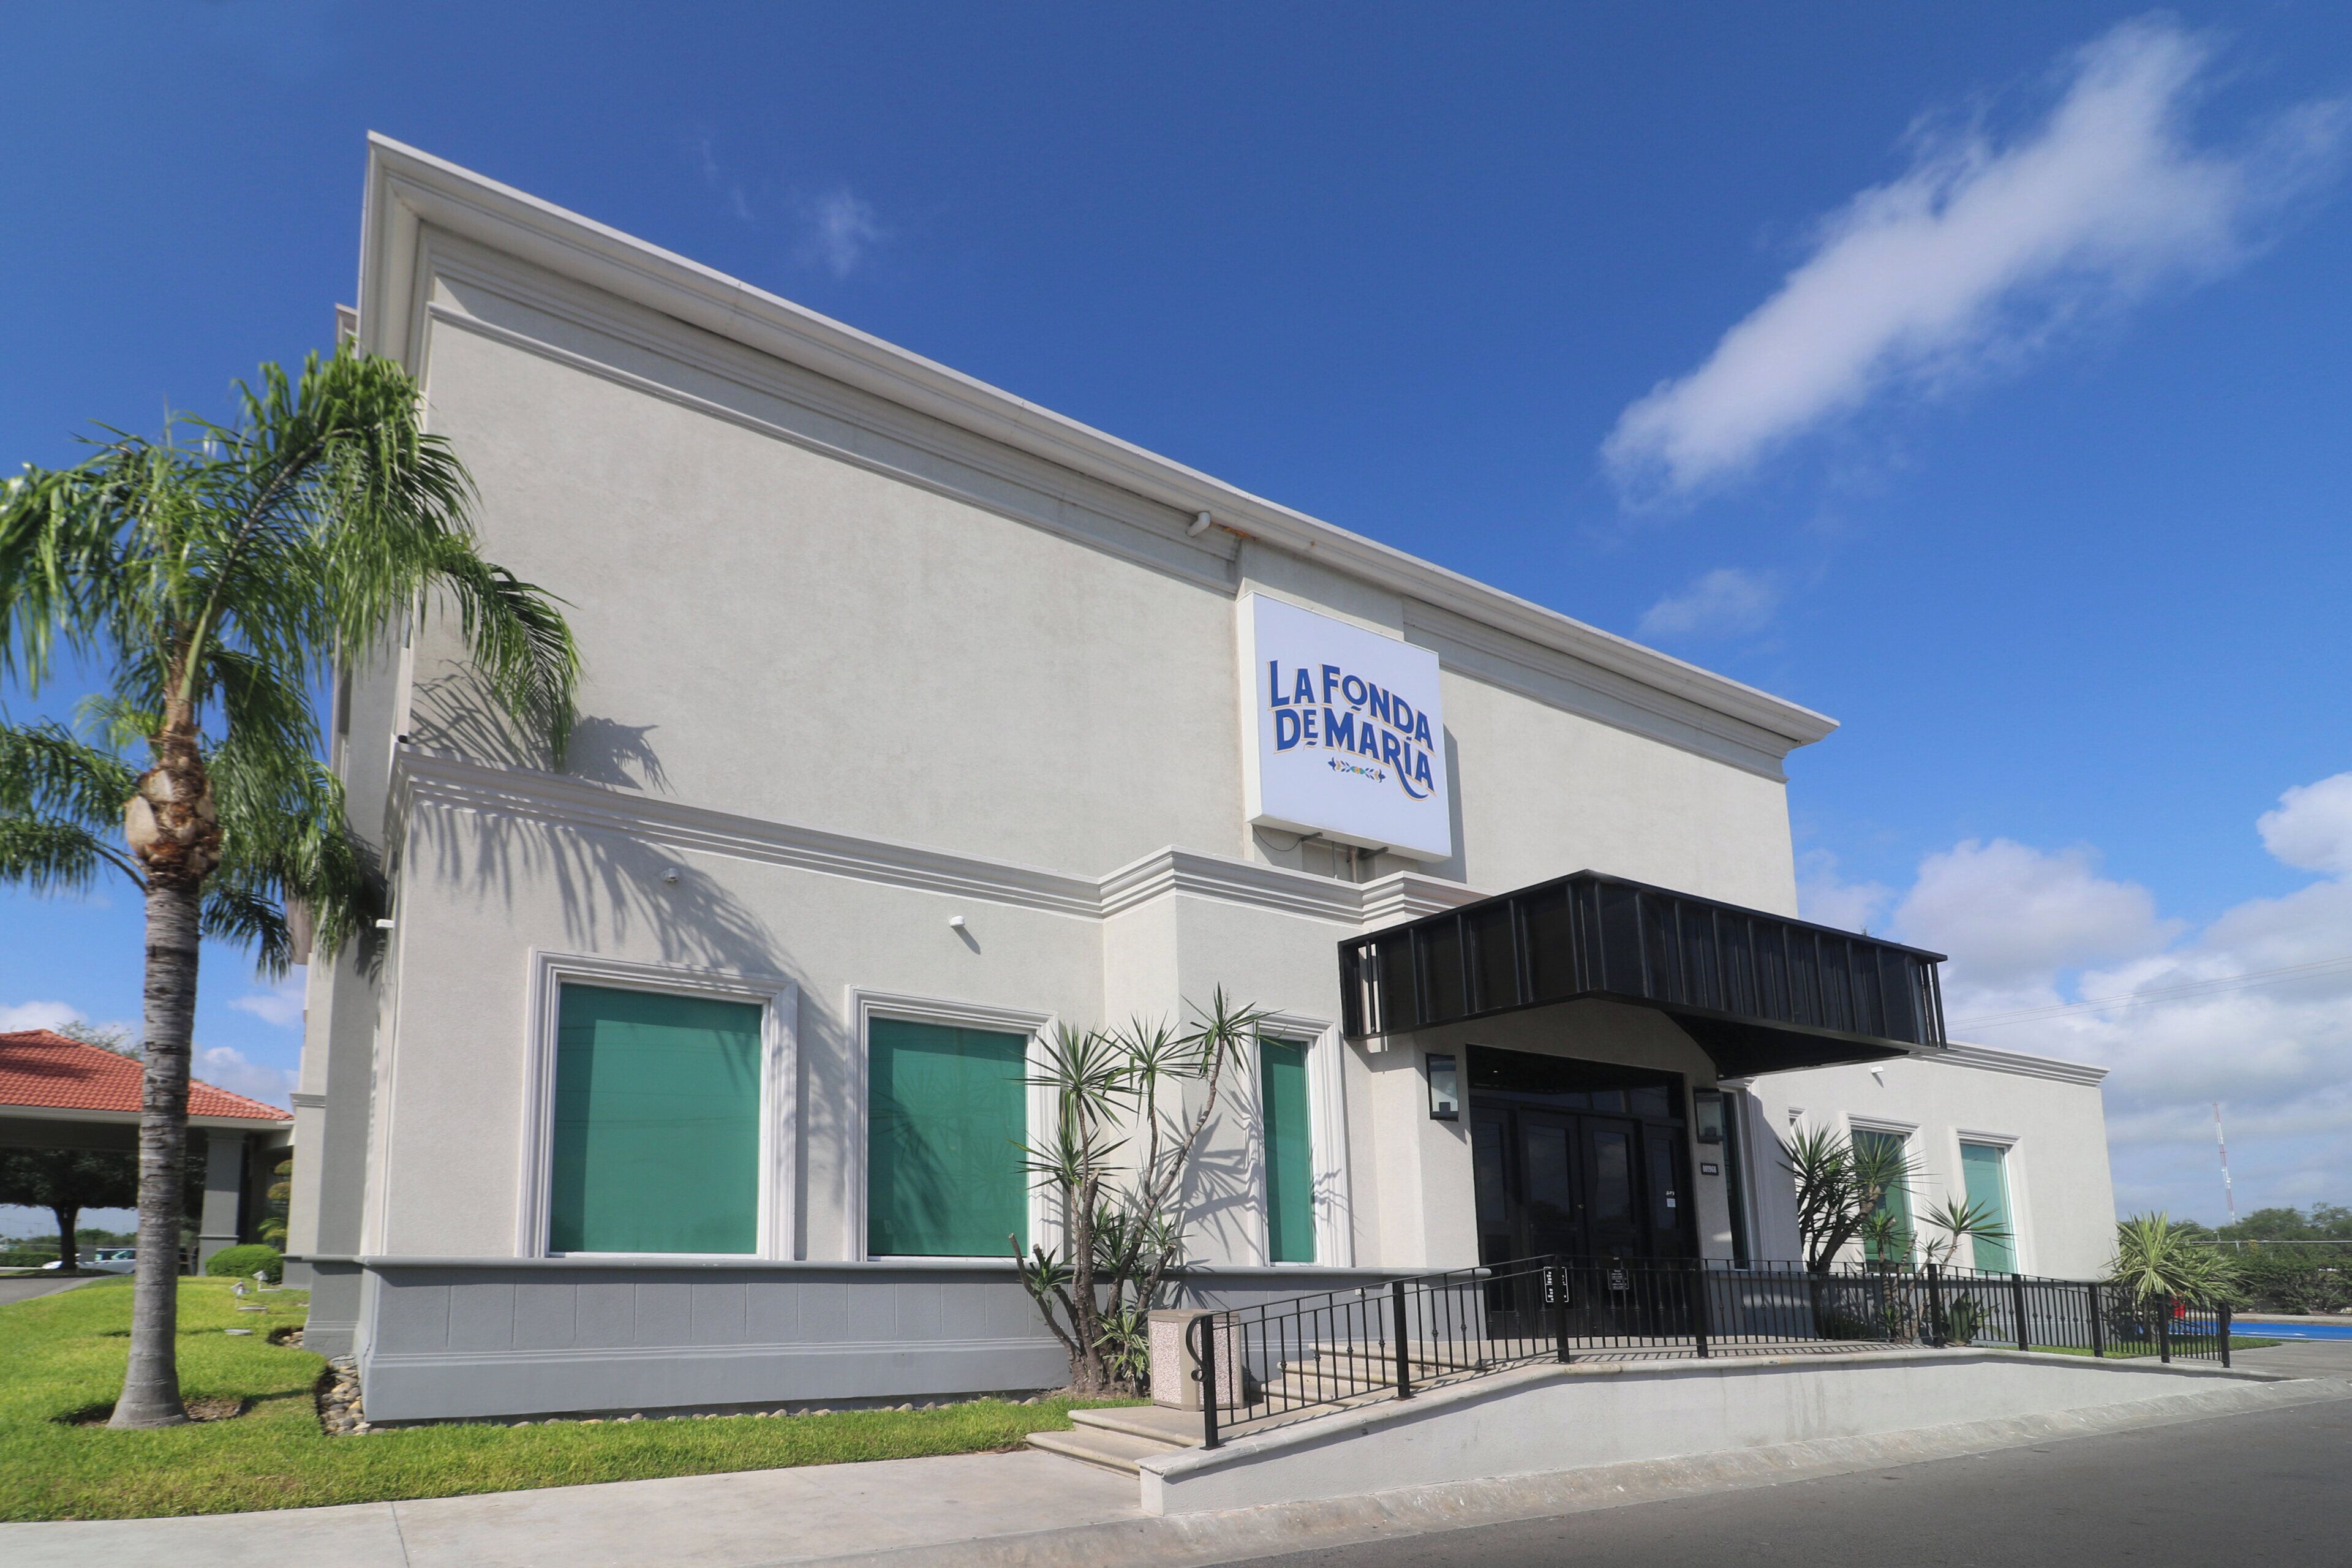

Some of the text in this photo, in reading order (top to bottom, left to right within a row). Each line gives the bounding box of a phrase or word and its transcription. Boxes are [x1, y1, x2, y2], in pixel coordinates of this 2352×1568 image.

[1269, 660, 1435, 753] LA FONDA
[1274, 708, 1319, 752] DE
